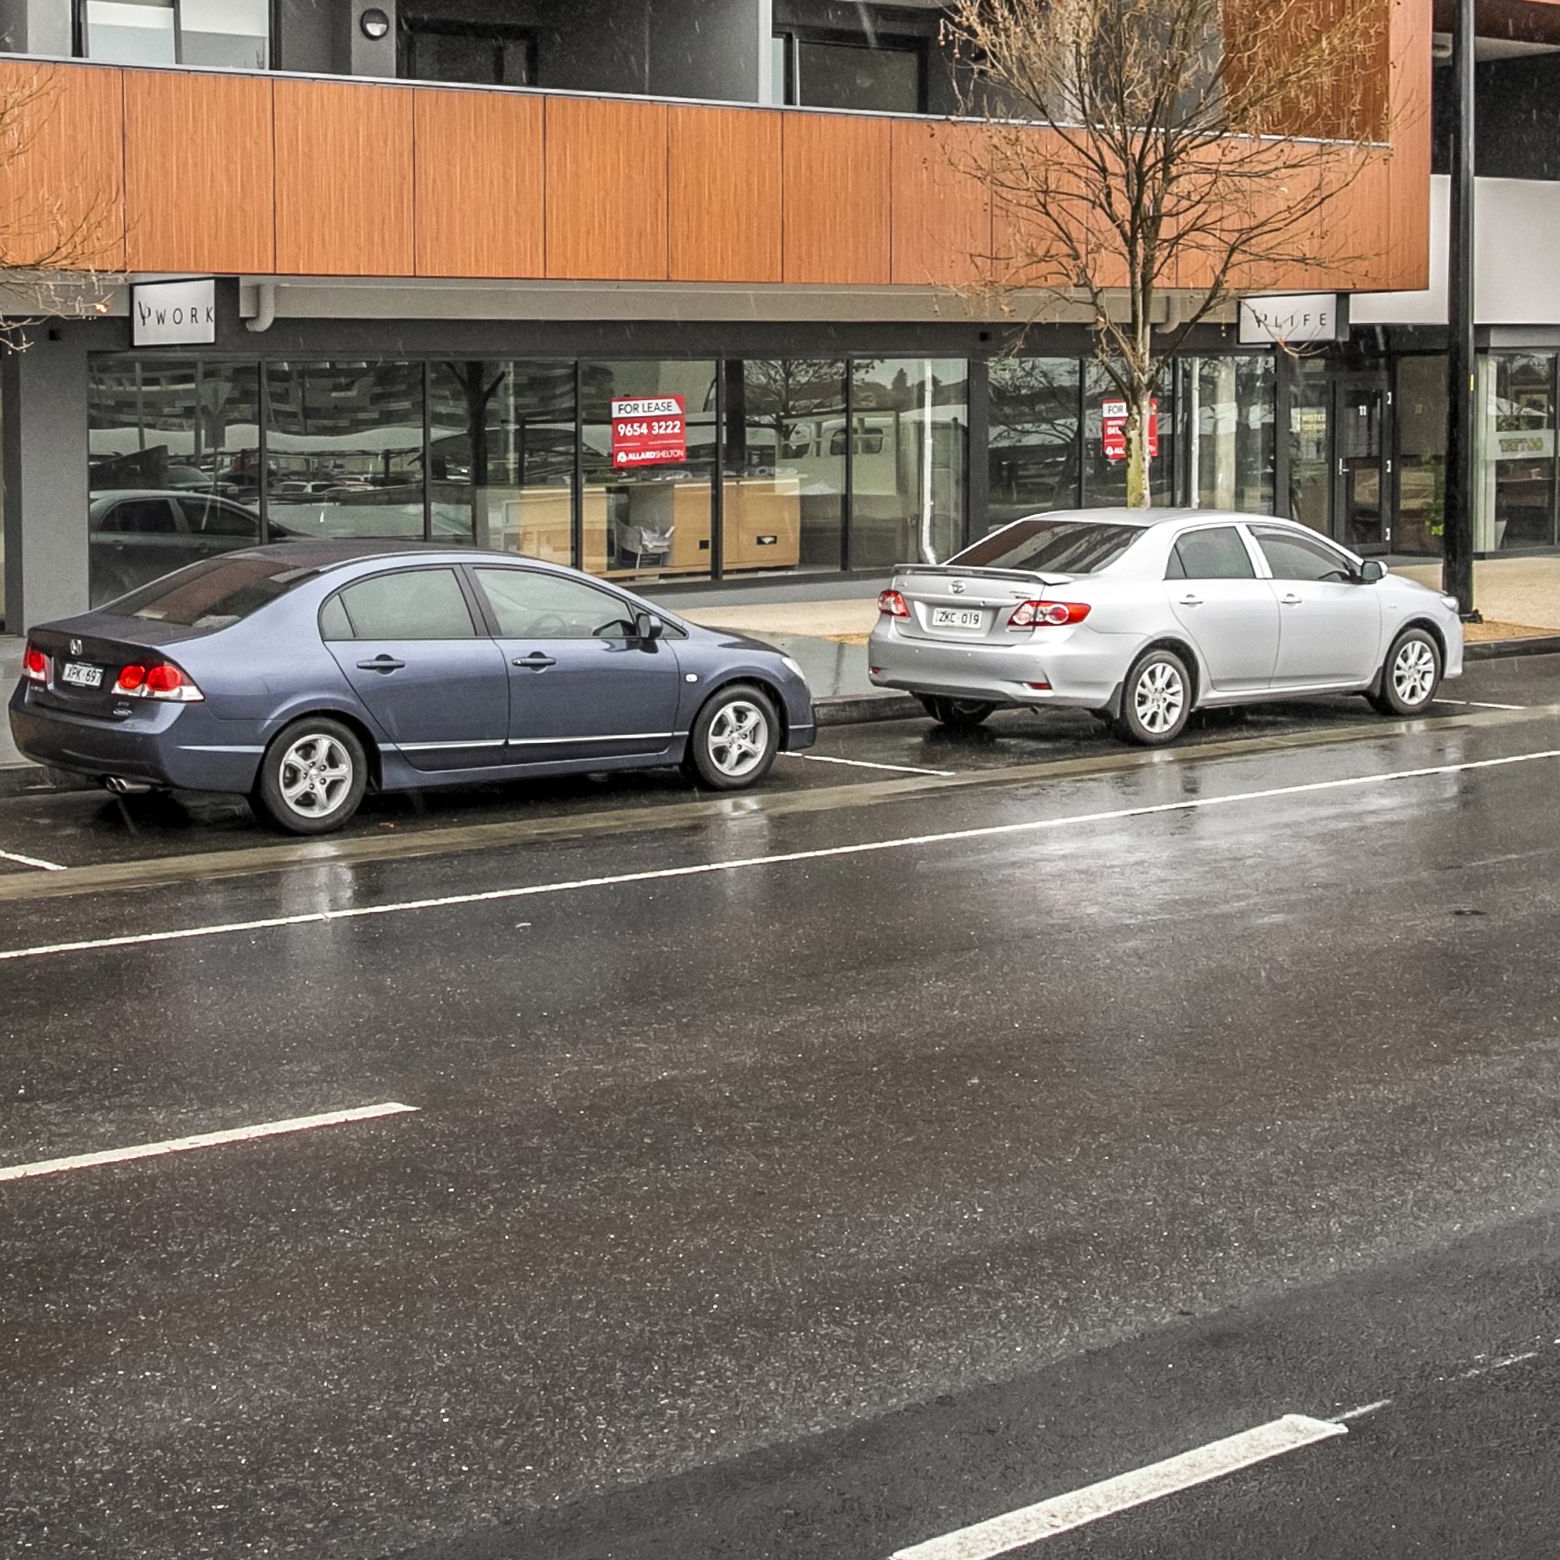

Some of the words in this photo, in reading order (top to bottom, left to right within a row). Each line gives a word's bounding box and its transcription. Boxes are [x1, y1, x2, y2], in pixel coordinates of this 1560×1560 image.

[618, 403, 639, 414] FOR
[642, 401, 672, 413] LEASE
[1108, 405, 1123, 414] FOR
[618, 423, 648, 436] 9654
[651, 421, 681, 434] 3222
